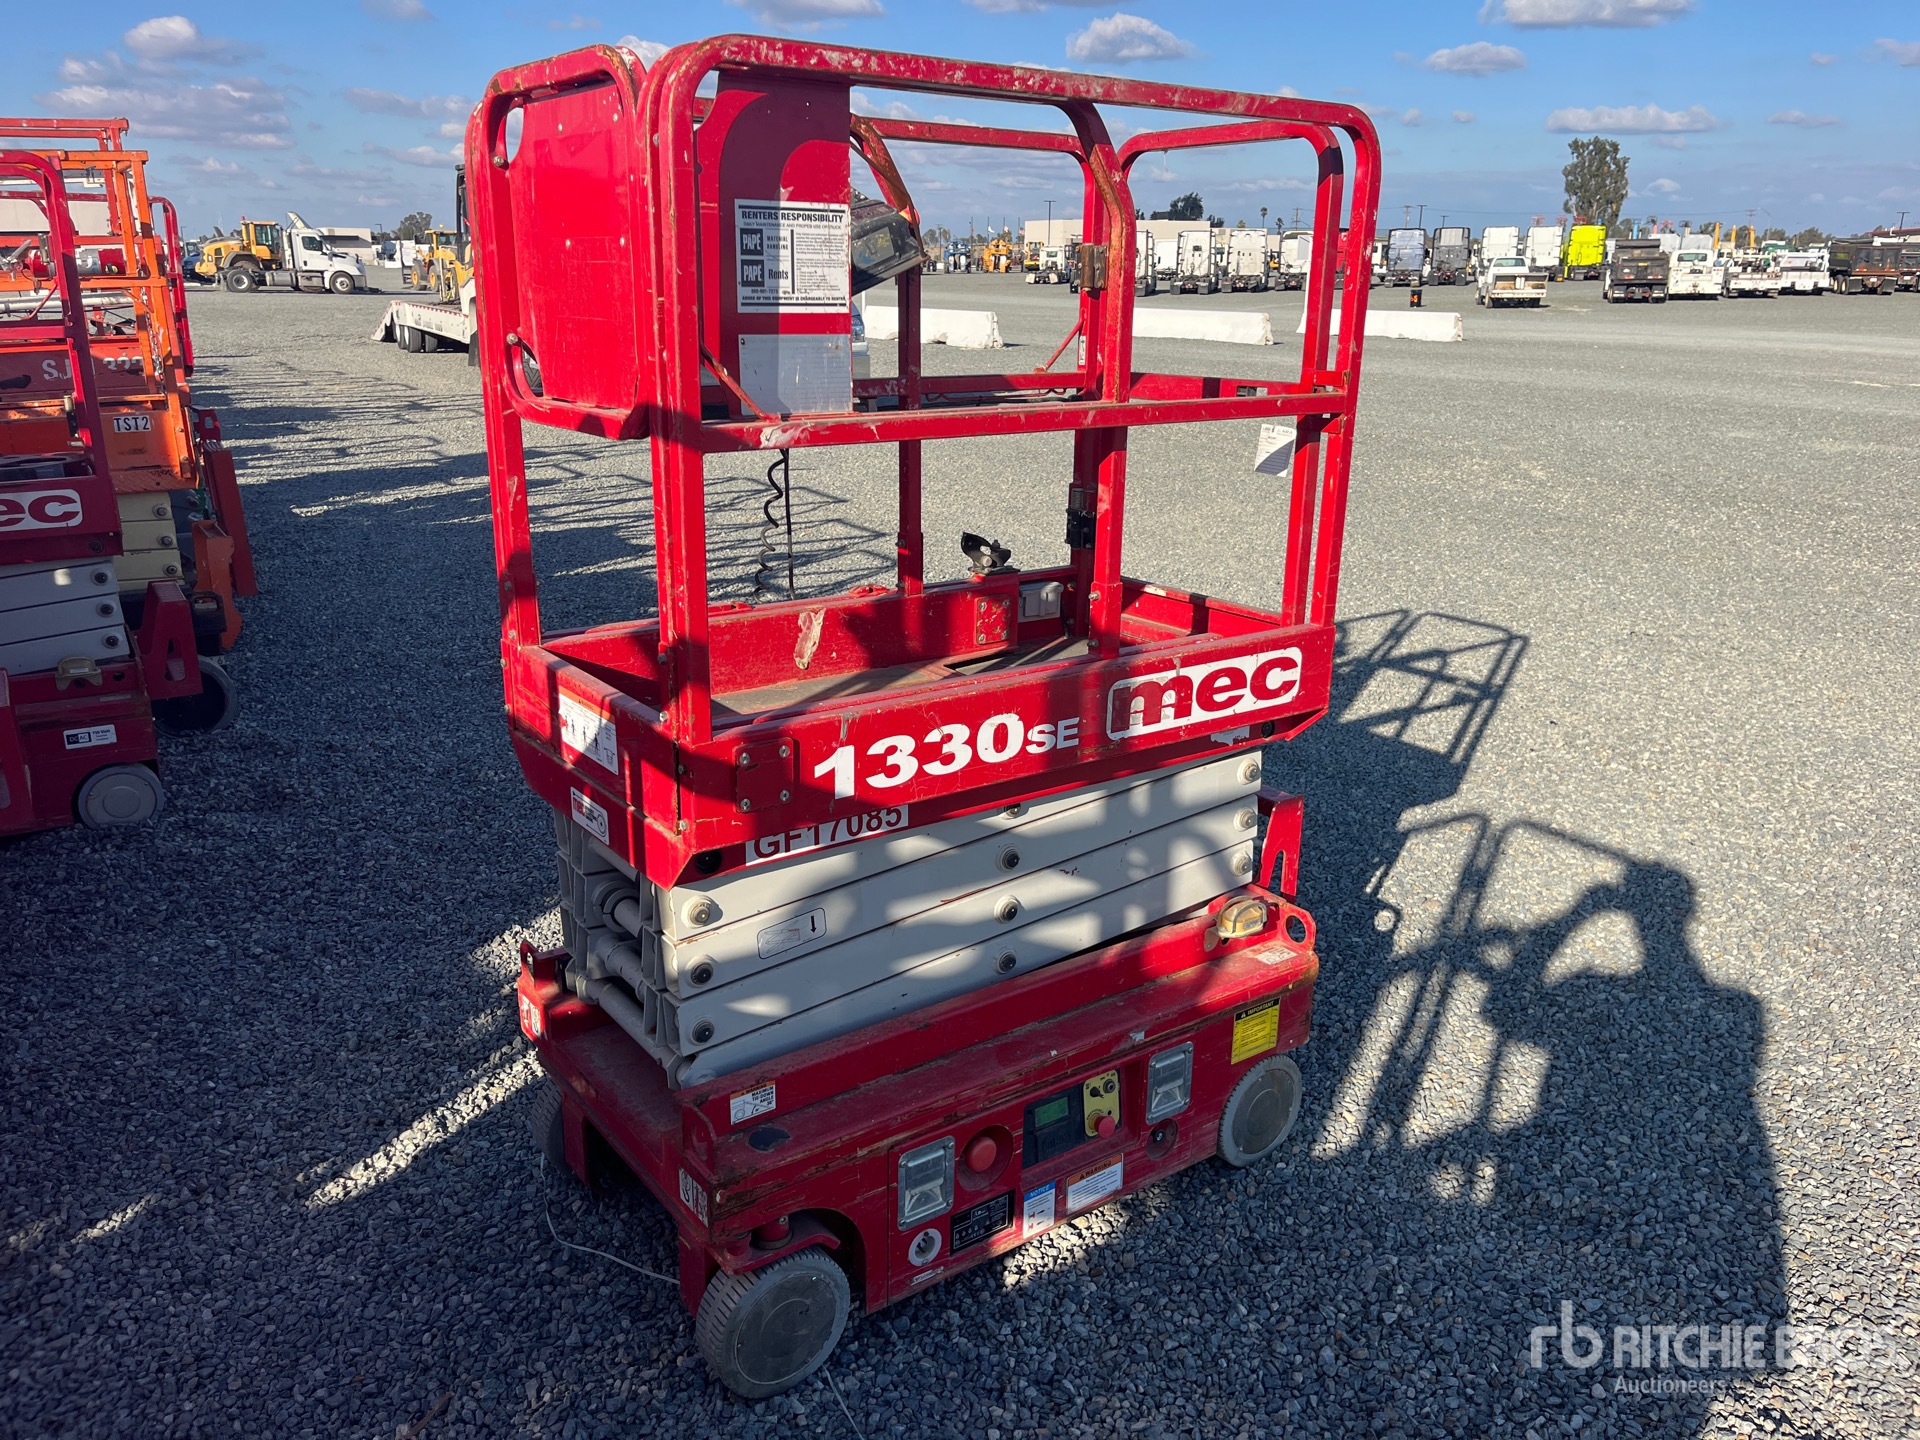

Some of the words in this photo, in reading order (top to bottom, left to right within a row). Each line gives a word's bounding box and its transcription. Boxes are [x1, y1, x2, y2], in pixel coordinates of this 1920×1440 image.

[742, 210, 779, 221] RENTERS
[781, 212, 843, 223] RESPONSIBILITY
[768, 269, 789, 280] Rents
[114, 416, 150, 432] TST2
[1110, 656, 1299, 734] mec
[753, 807, 902, 859] GF17085
[1247, 1000, 1275, 1015] IMPORTANT
[751, 1086, 774, 1097] MAXIMUM
[1085, 1160, 1112, 1178] WARNING
[1029, 1184, 1050, 1198] NOTICE
